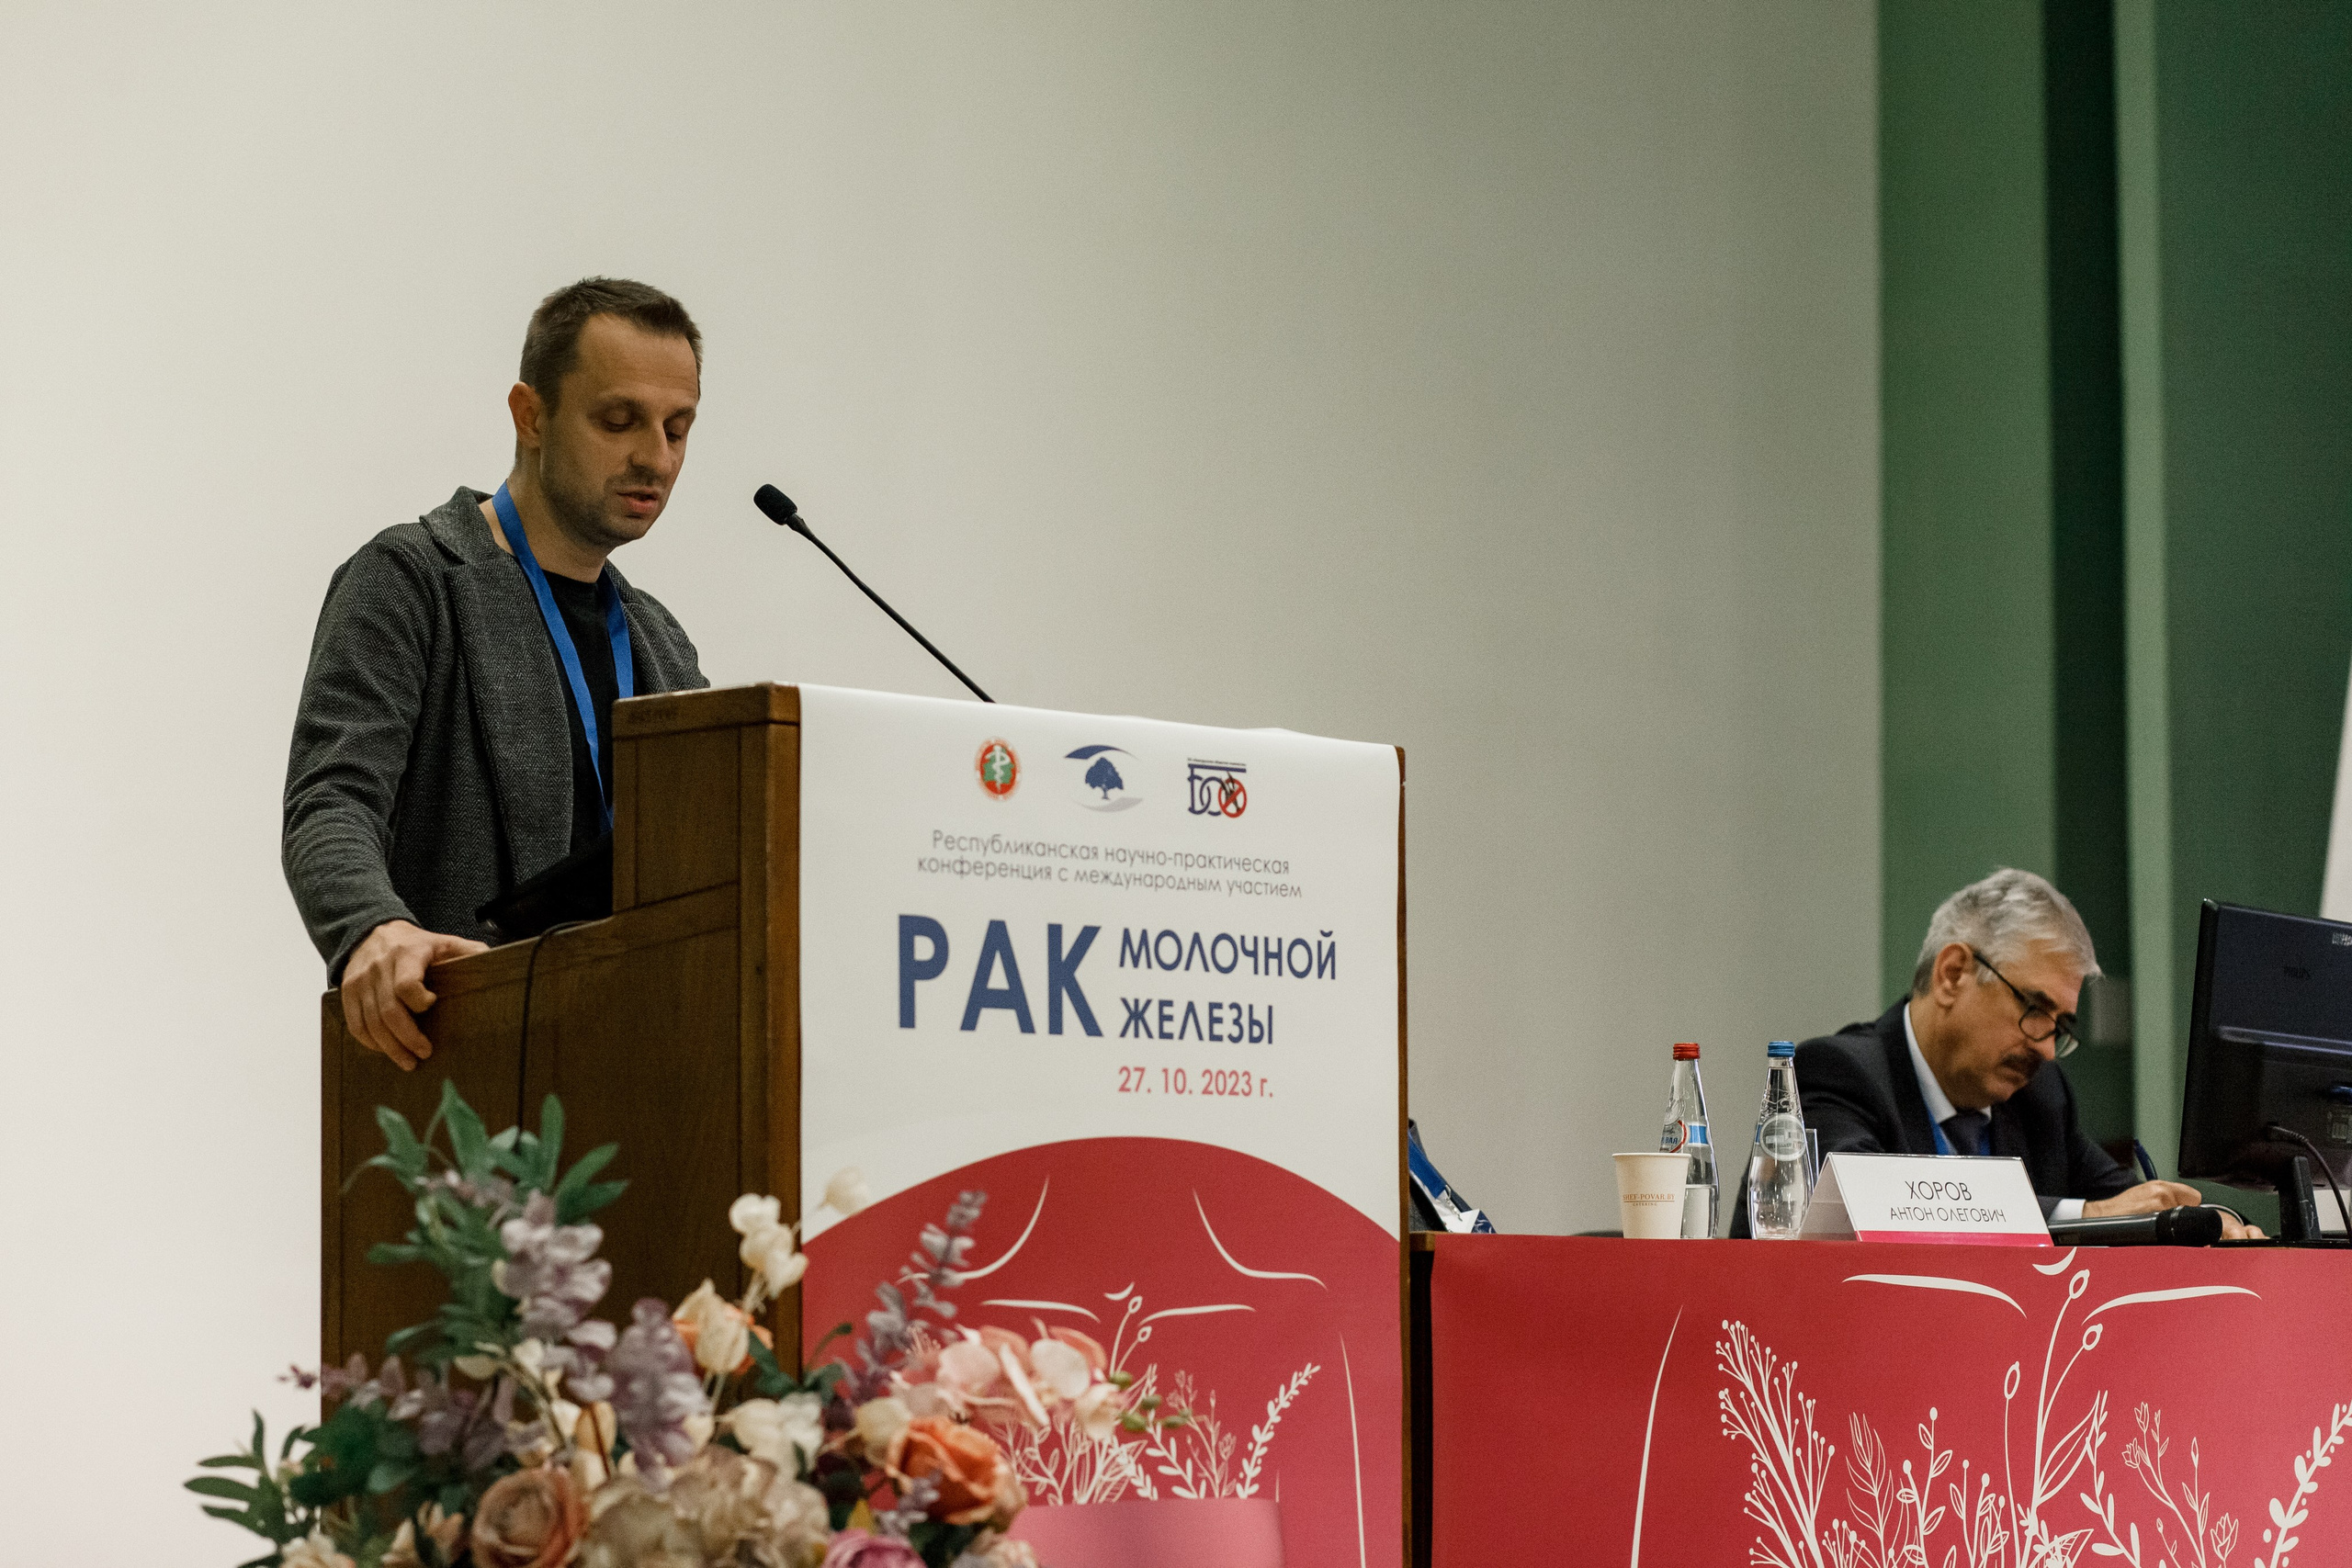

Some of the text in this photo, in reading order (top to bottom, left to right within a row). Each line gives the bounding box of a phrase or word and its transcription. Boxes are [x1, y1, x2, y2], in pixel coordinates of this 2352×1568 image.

[932, 829, 1290, 874] Республиканская научно-практическая
[917, 855, 1303, 898] конференция с международным участием
[898, 914, 1104, 1037] РАК
[1119, 928, 1336, 980] МОЛОЧНОЙ
[1119, 997, 1273, 1044] ЖЕЛЕЗЫ
[1118, 1066, 1274, 1099] 27. 10. 2023 г.
[1905, 1180, 1973, 1201] ХОРОВ
[1890, 1206, 2007, 1223] АНТОН ОЛЕГОВИЧ
